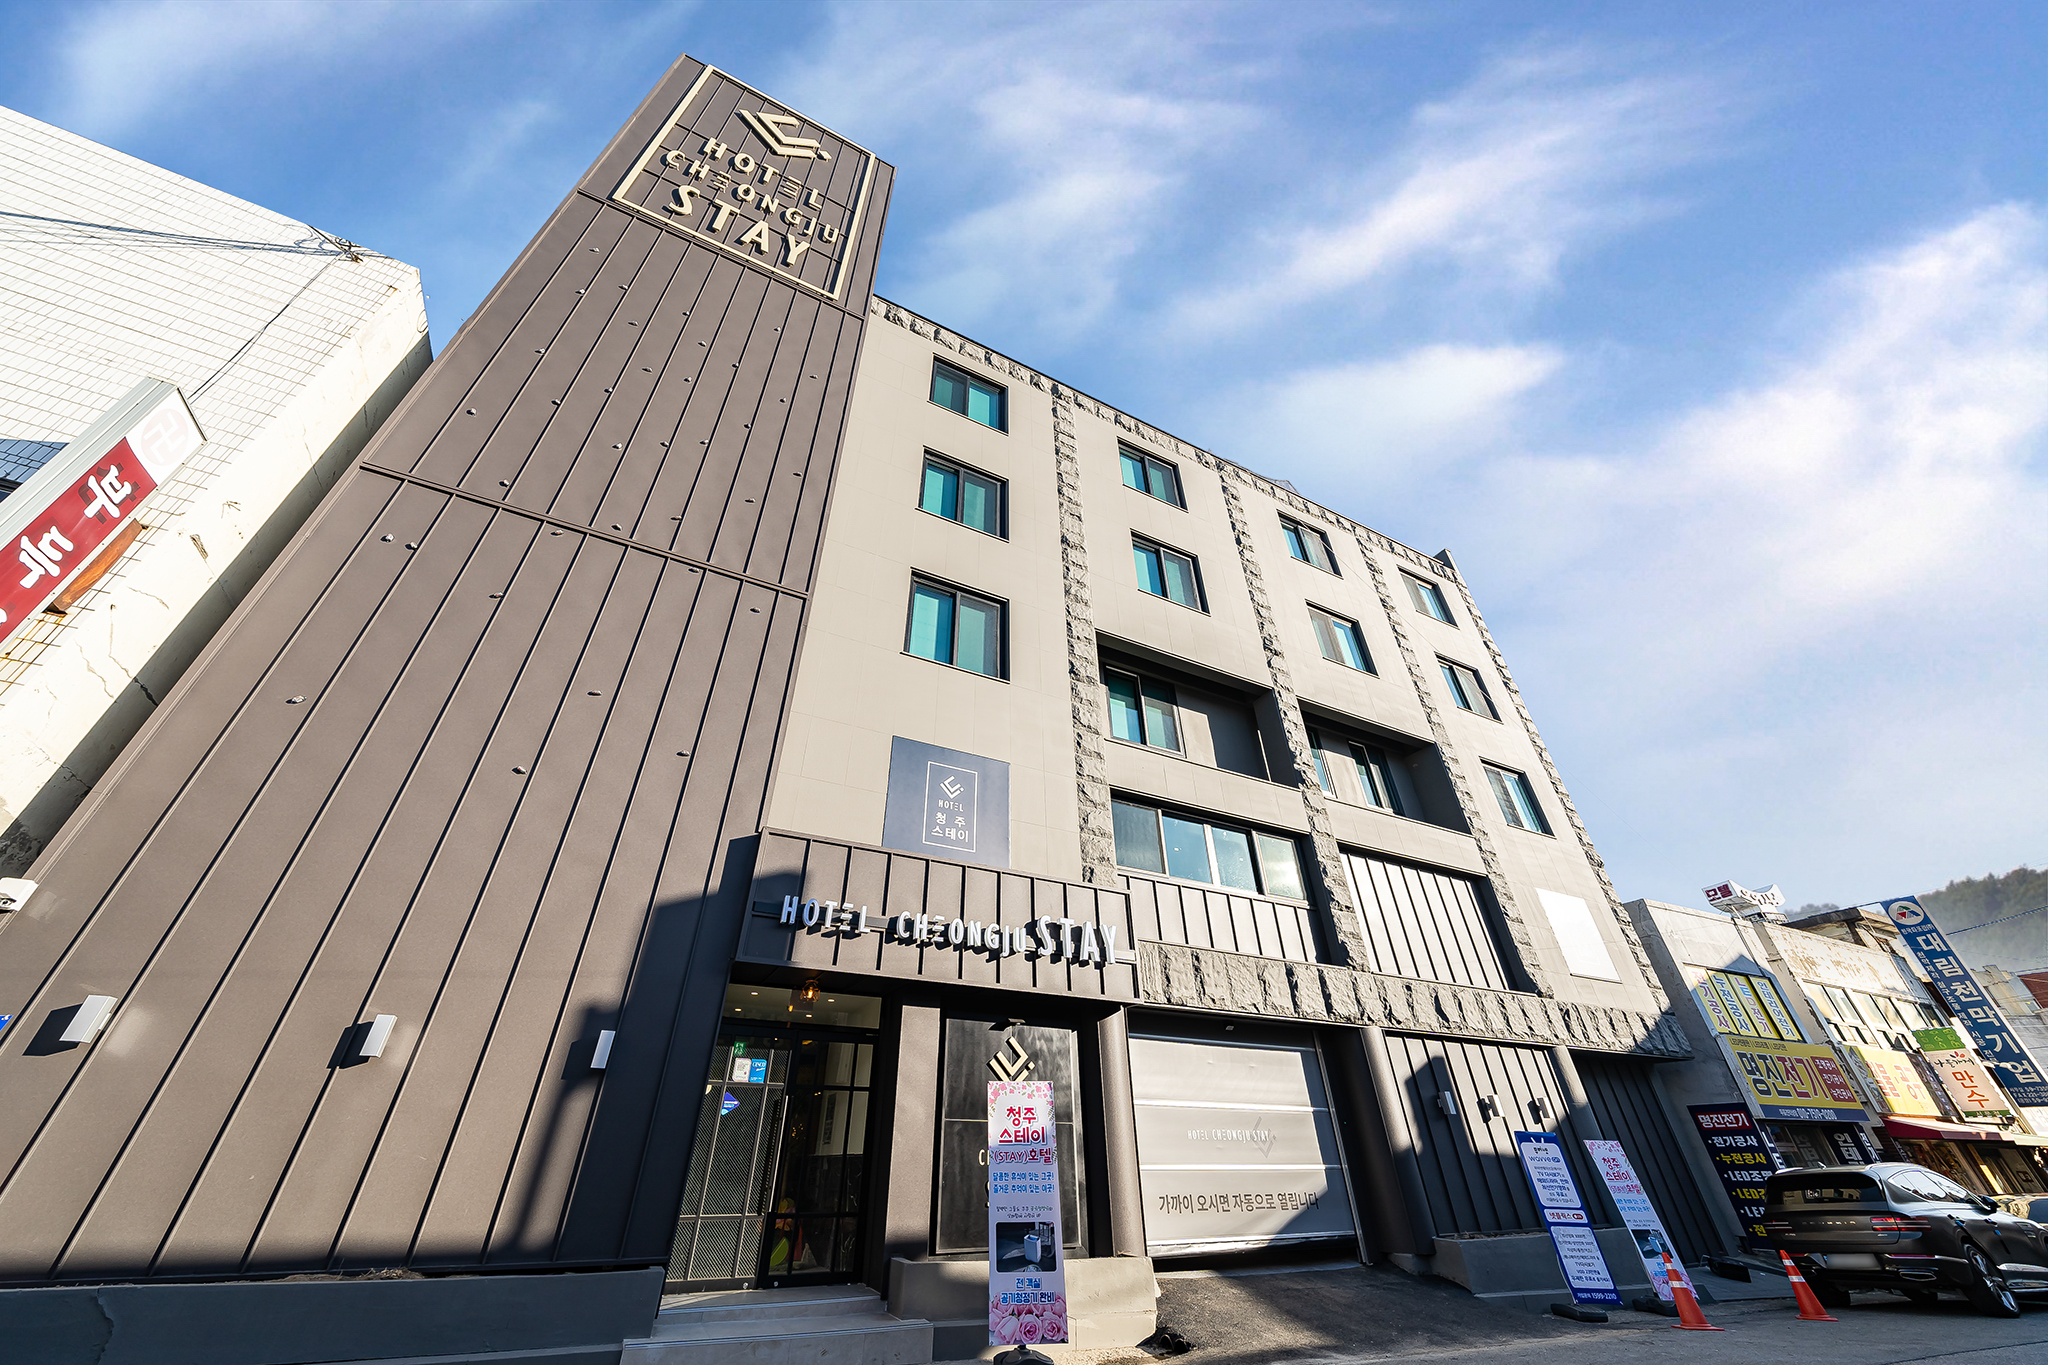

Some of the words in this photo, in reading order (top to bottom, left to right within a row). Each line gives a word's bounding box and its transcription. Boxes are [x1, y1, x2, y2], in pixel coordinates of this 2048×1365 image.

[702, 136, 823, 211] HOTEL
[664, 149, 840, 244] CHEONGJU
[667, 184, 811, 268] STAY
[938, 799, 964, 813] HOTEL
[931, 825, 969, 843] 스테이
[779, 894, 872, 934] HOTEL
[896, 910, 1028, 959] CHEONGJU
[1036, 914, 1117, 965] STAY
[1712, 974, 1751, 1033] 누전공사
[1734, 976, 1773, 1035] LED전기
[1757, 980, 1797, 1039] 인테리어전기
[1735, 1050, 1830, 1101] 명진전기
[1951, 1069, 1989, 1109] 만수
[1006, 1105, 1037, 1128] 청주
[1698, 1113, 1750, 1128] 명진전기
[998, 1125, 1046, 1144] 스테이
[1187, 1129, 1209, 1141] HOTEL
[1212, 1128, 1251, 1144] CHEONGJU
[1252, 1129, 1271, 1142] STAY
[1712, 1135, 1759, 1148] 전기공사
[993, 1147, 1052, 1164] (STAY)호텔
[1602, 1156, 1621, 1171] 청주
[1721, 1153, 1768, 1165] 누전공사
[1028, 1171, 1040, 1182] 있는
[1041, 1171, 1055, 1182] 그곳!
[1606, 1171, 1632, 1181] 스테이
[1029, 1184, 1040, 1194] 있는
[1158, 1193, 1195, 1214] 가까이
[1196, 1193, 1232, 1213] 오시면
[1232, 1192, 1277, 1213] 자동으로
[1277, 1191, 1320, 1211] 열립니다
[1016, 1277, 1024, 1289] 전
[1026, 1277, 1041, 1289] 객실
[1001, 1291, 1038, 1304] 공기청정기
[1039, 1291, 1055, 1303] 완비
